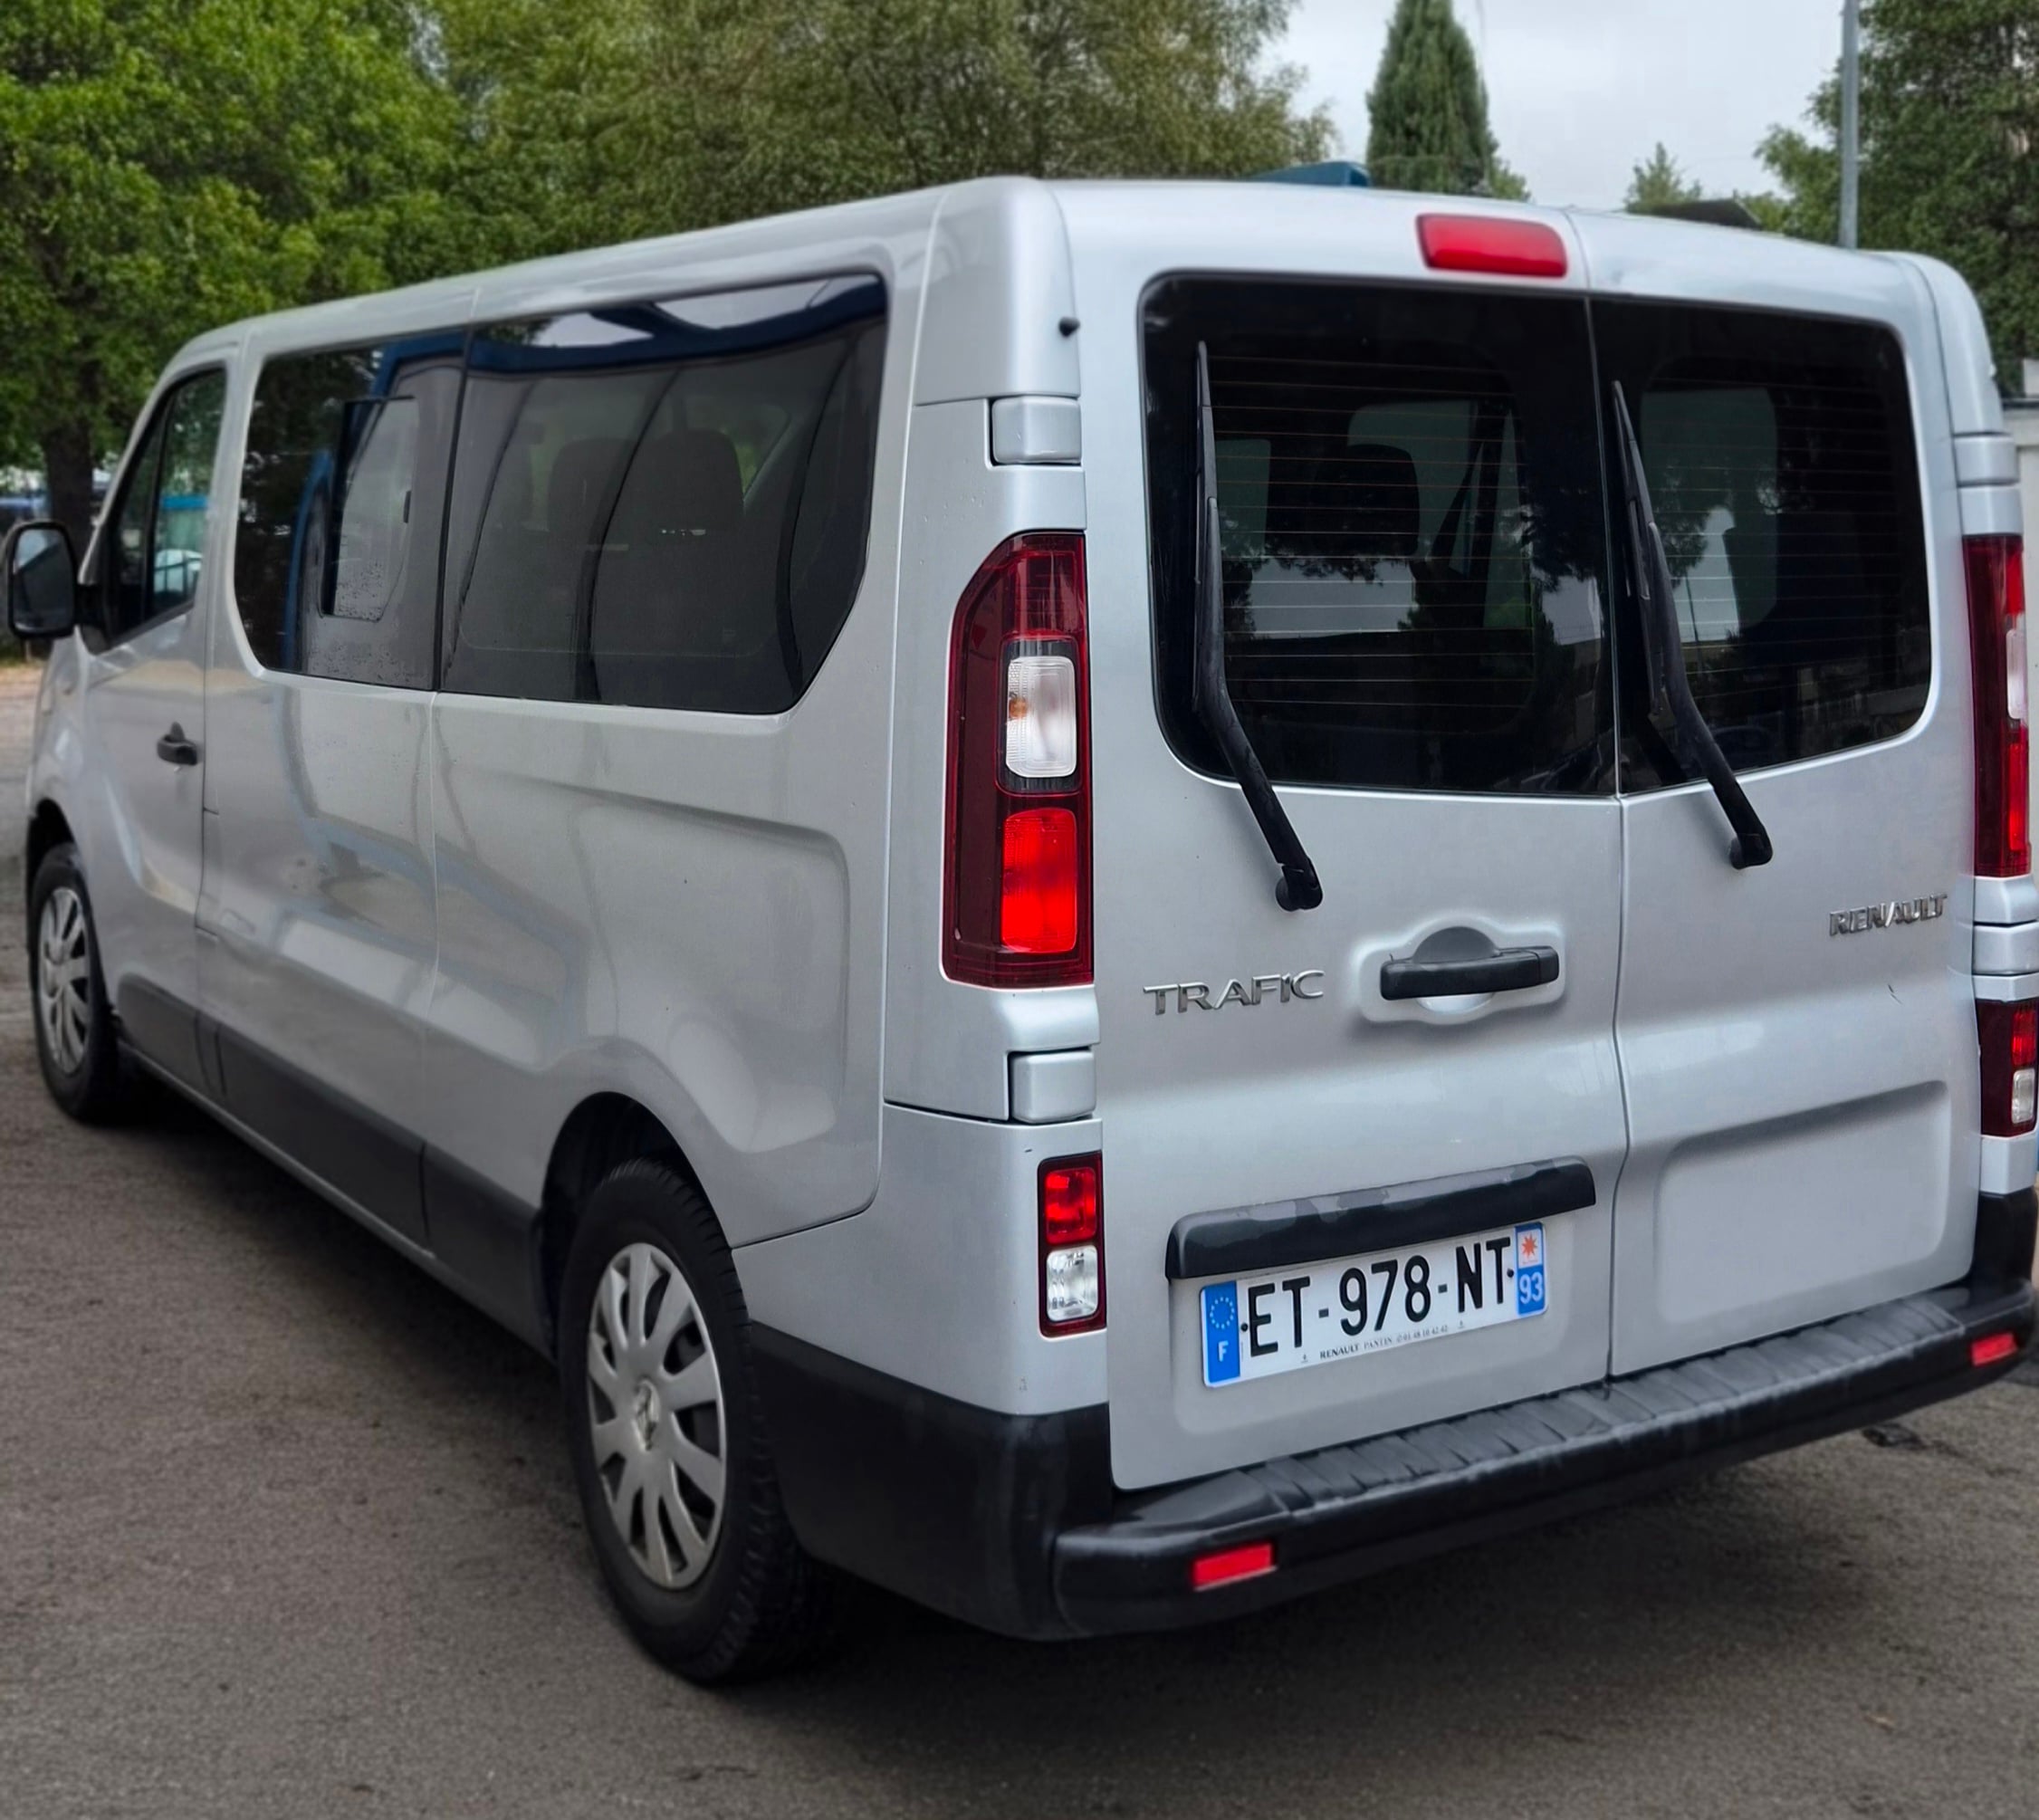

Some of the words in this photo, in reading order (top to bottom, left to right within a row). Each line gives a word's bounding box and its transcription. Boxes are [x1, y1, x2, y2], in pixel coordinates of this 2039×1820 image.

[1830, 893, 1948, 936] RENAULT
[1143, 970, 1325, 1015] TRAFIC
[1519, 1271, 1544, 1304] 93
[1218, 1340, 1229, 1362] F
[1319, 1343, 1360, 1359] RENAULT
